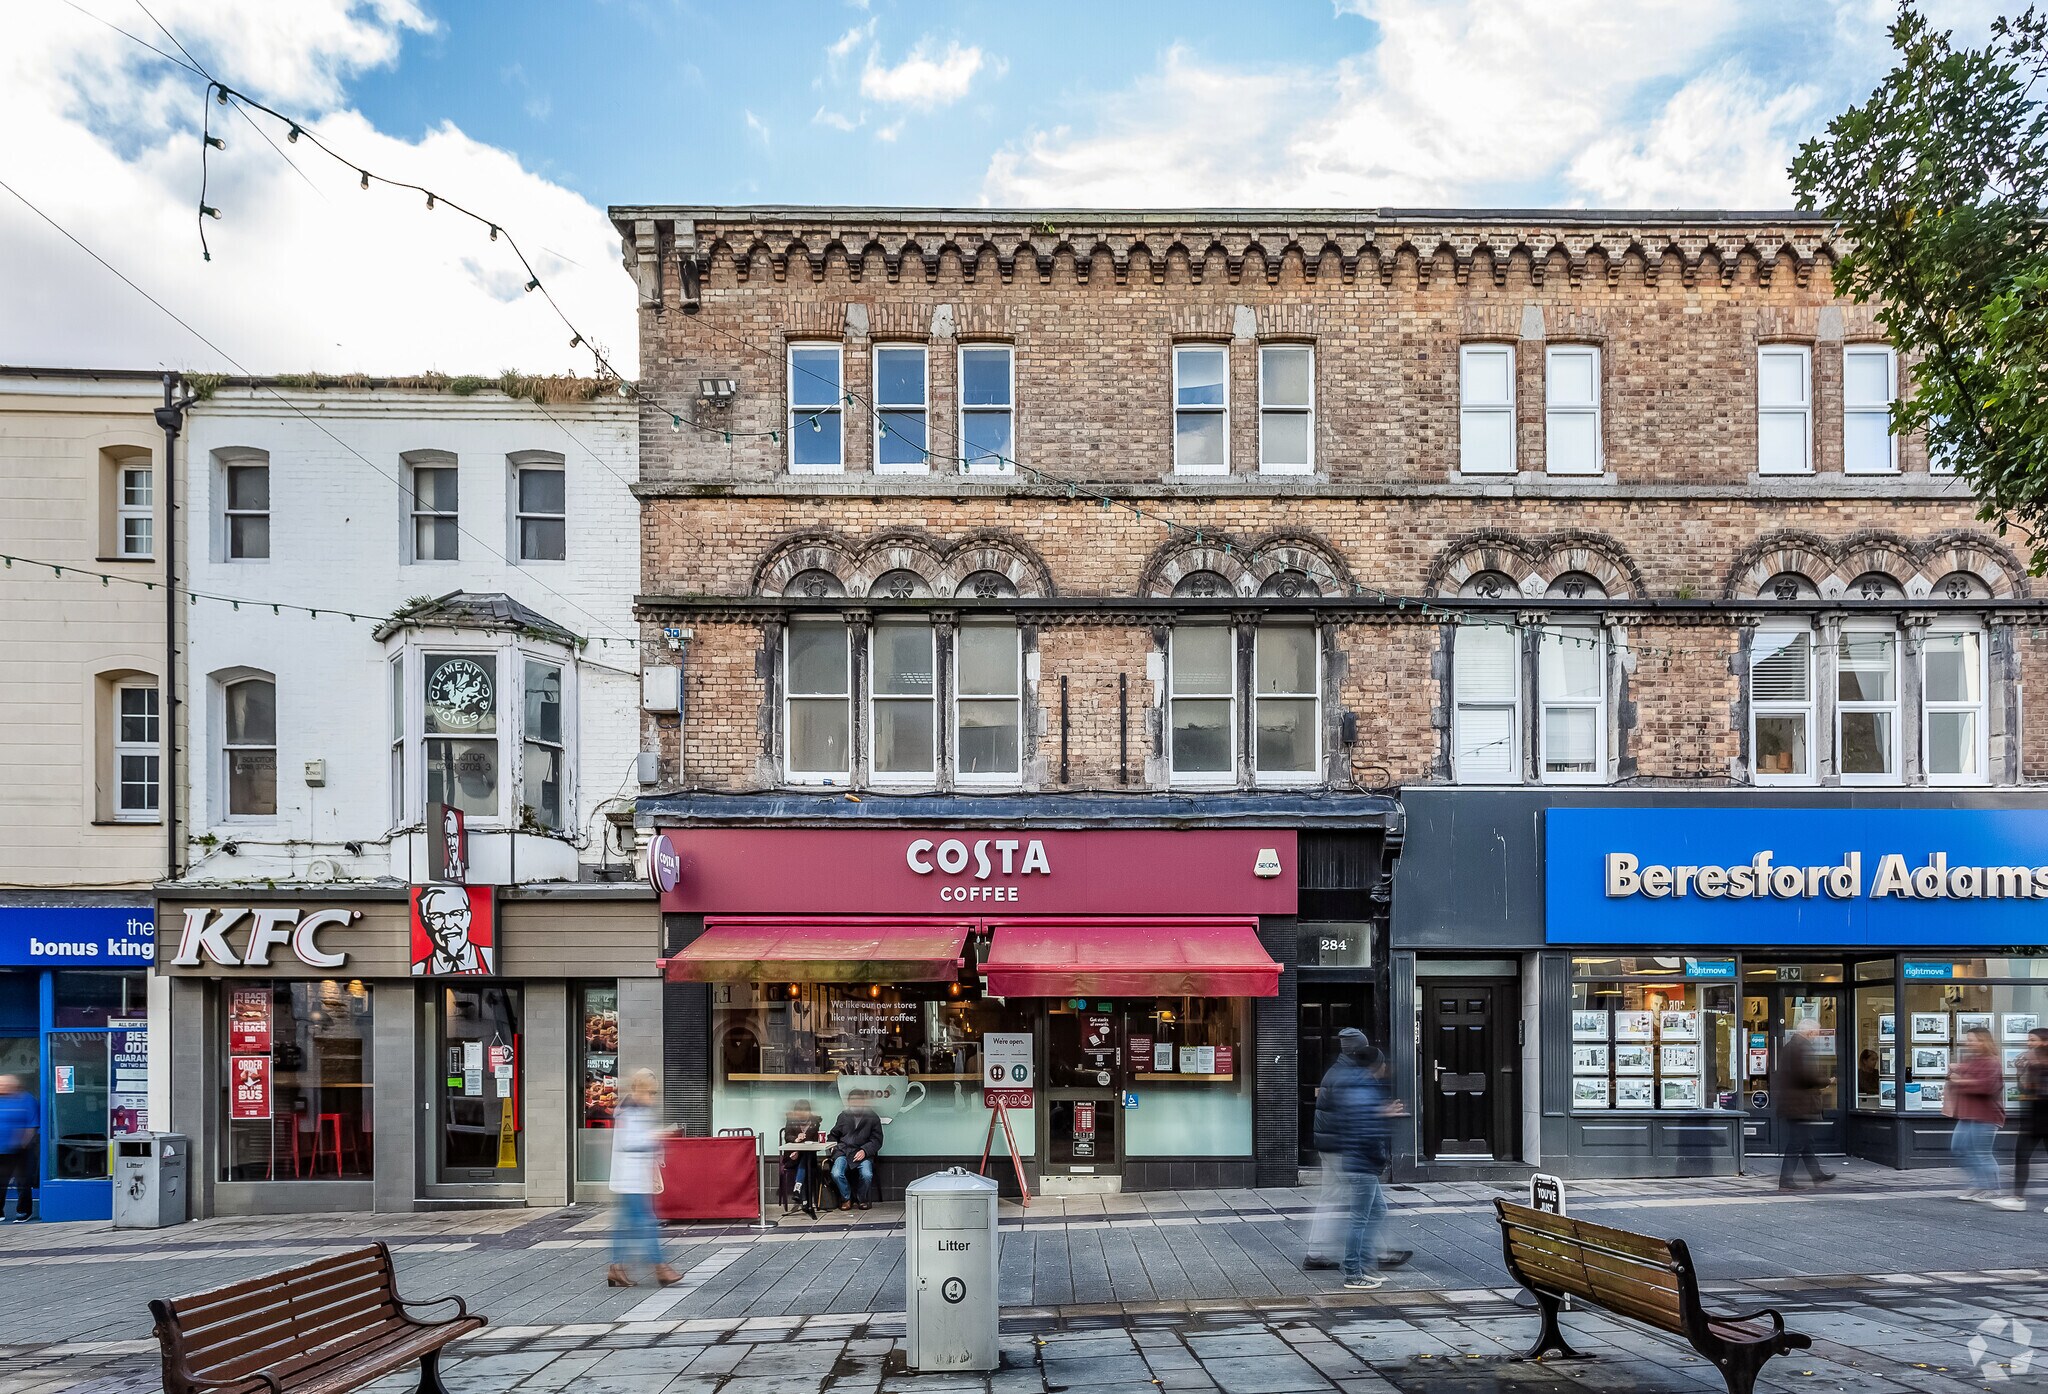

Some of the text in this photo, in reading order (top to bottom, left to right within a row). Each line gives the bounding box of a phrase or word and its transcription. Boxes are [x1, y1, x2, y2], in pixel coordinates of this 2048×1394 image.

[432, 662, 480, 699] CLEMENT
[435, 707, 479, 725] JONES
[660, 852, 675, 868] COSTA
[906, 839, 1051, 879] COSTA
[1605, 850, 2048, 899] Beresford Adams
[940, 887, 1018, 902] COFFEE
[127, 918, 154, 936] the
[171, 908, 351, 967] KFC
[30, 938, 155, 960] bonus king
[1321, 939, 1347, 950] 284
[1688, 966, 1727, 976] rightmove
[1905, 968, 1944, 977] rightmove
[831, 1000, 844, 1009] We
[845, 1000, 860, 1009] like
[893, 1001, 917, 1009] stores
[831, 1013, 846, 1022] like
[860, 1013, 873, 1022] like
[244, 1025, 267, 1033] BACK
[858, 1026, 889, 1035] crafted.
[114, 1054, 147, 1062] GUARAN
[238, 1060, 262, 1069] ORDER
[238, 1090, 262, 1100] BUS
[1537, 1187, 1557, 1202] YOU'VE
[938, 1240, 971, 1251] Litter
